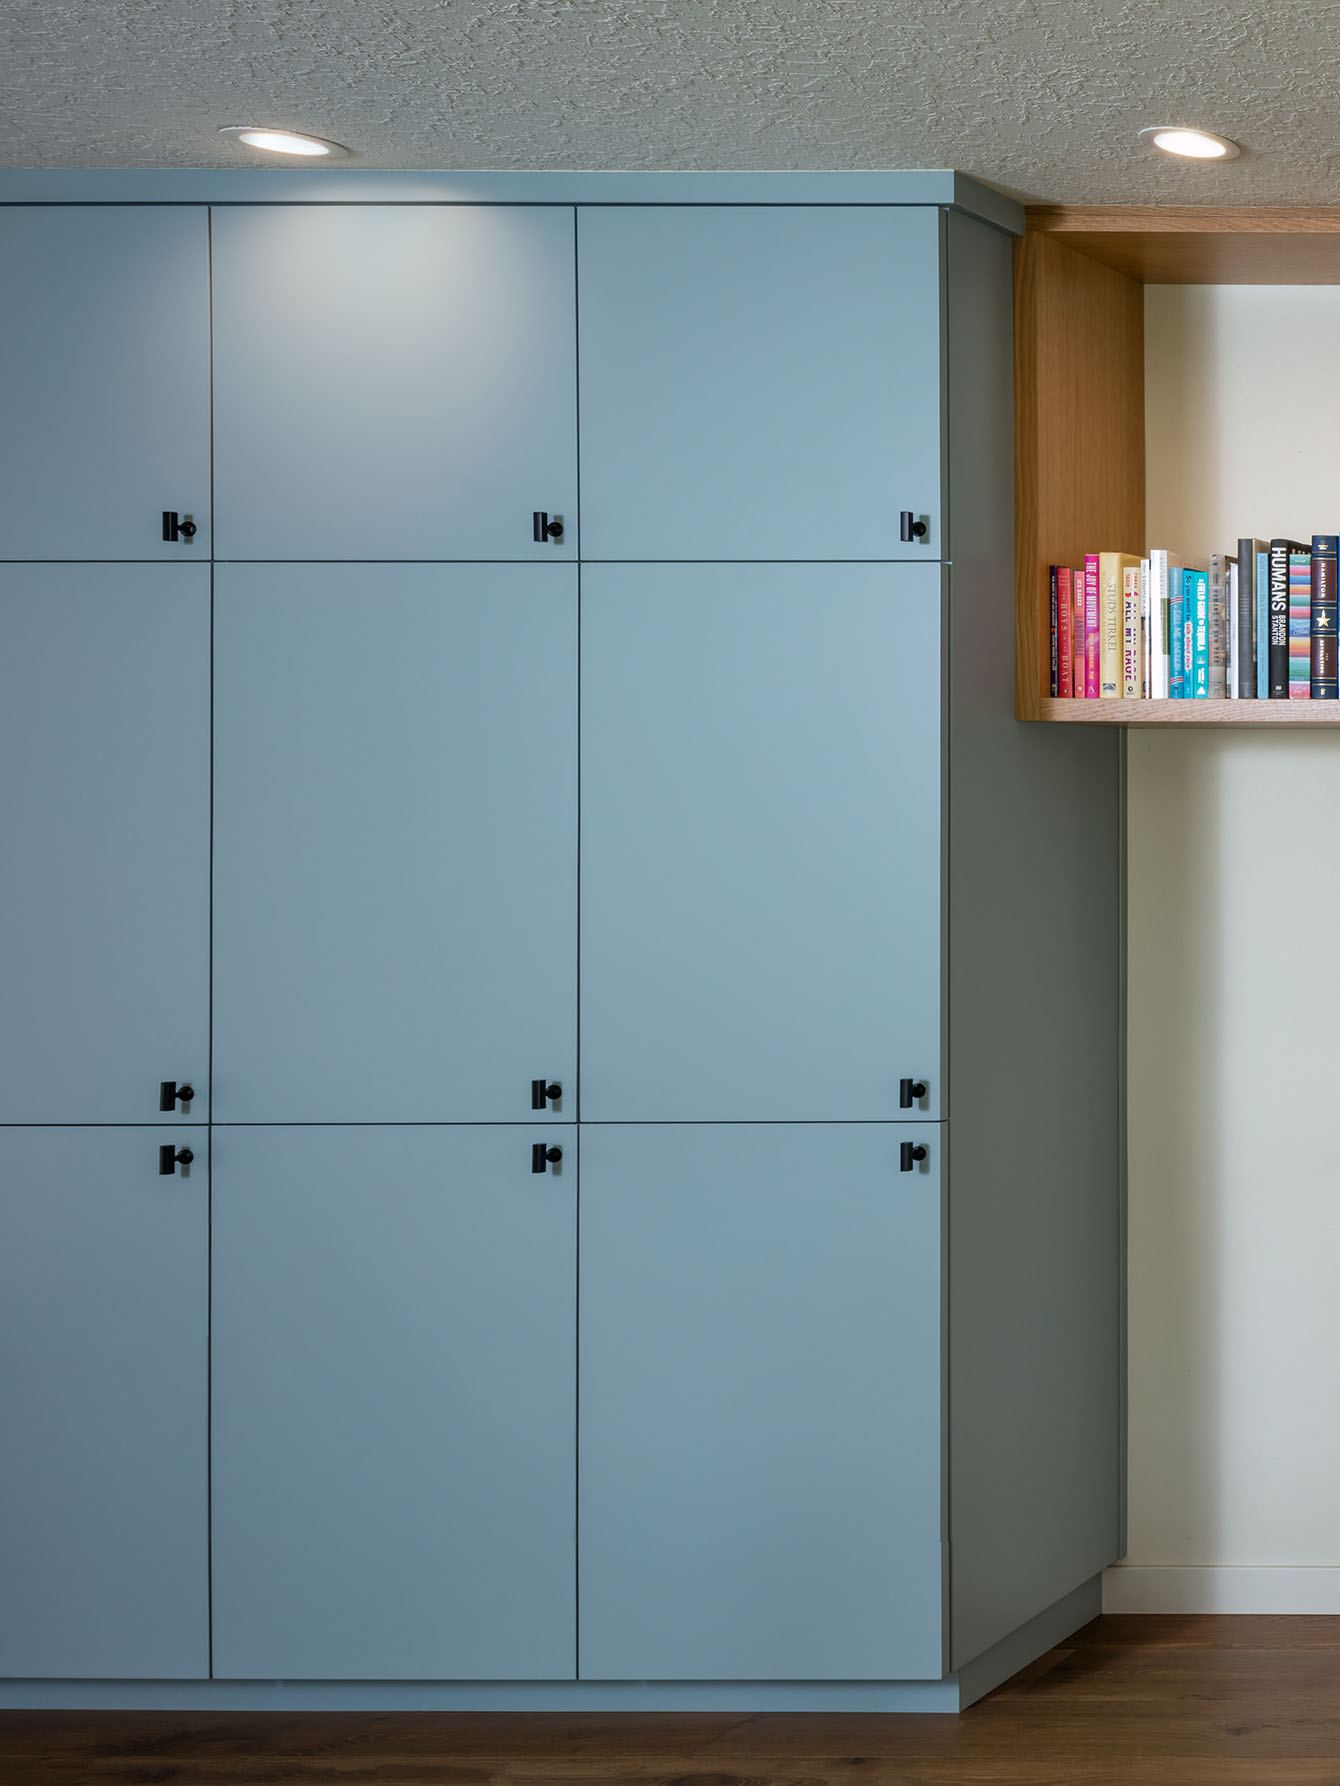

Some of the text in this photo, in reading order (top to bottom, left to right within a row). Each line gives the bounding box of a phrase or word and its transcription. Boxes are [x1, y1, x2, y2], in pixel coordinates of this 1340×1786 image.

[1086, 562, 1097, 627] THE JOY OF MOVEMENT
[1272, 547, 1286, 611] HUMANS
[1107, 584, 1116, 653] STUDS TERKEL
[1125, 602, 1136, 681] ALL MY RAGE
